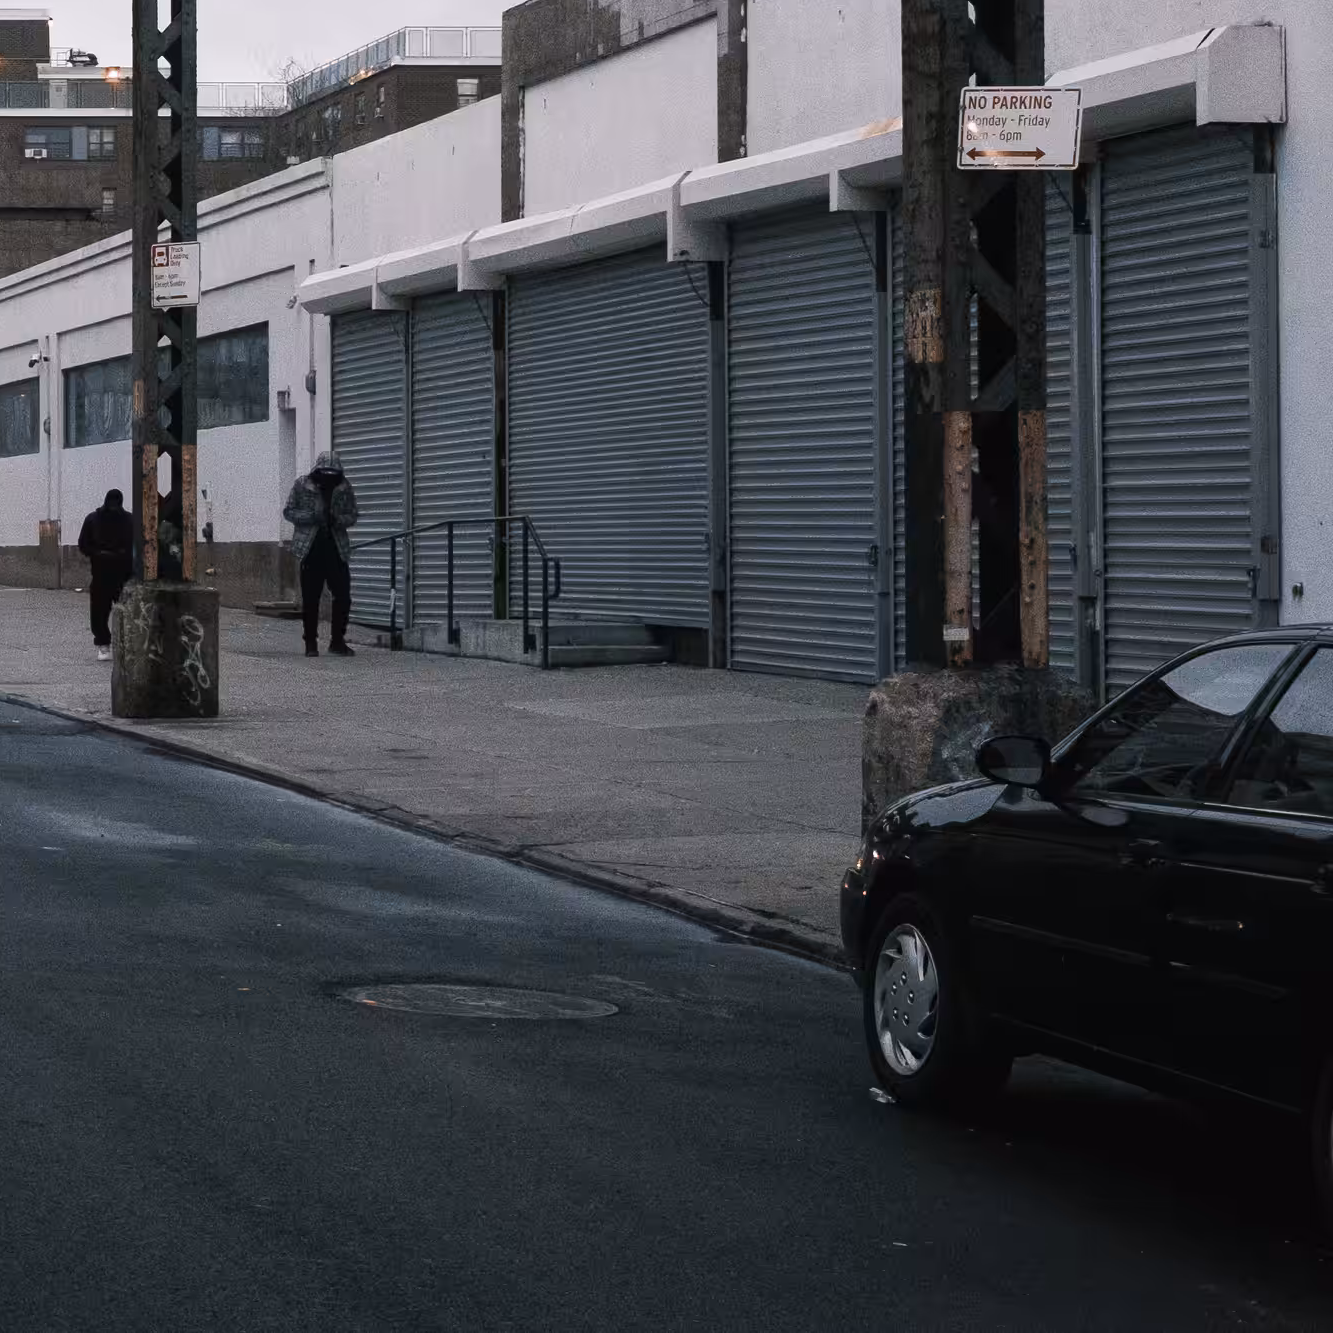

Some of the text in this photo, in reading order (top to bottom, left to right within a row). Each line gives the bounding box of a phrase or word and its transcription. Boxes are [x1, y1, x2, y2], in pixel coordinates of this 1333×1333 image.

[968, 95, 1053, 109] NO PARKING
[967, 114, 1007, 128] Monday
[1018, 114, 1051, 128] Friday
[999, 129, 1022, 143] 6pm
